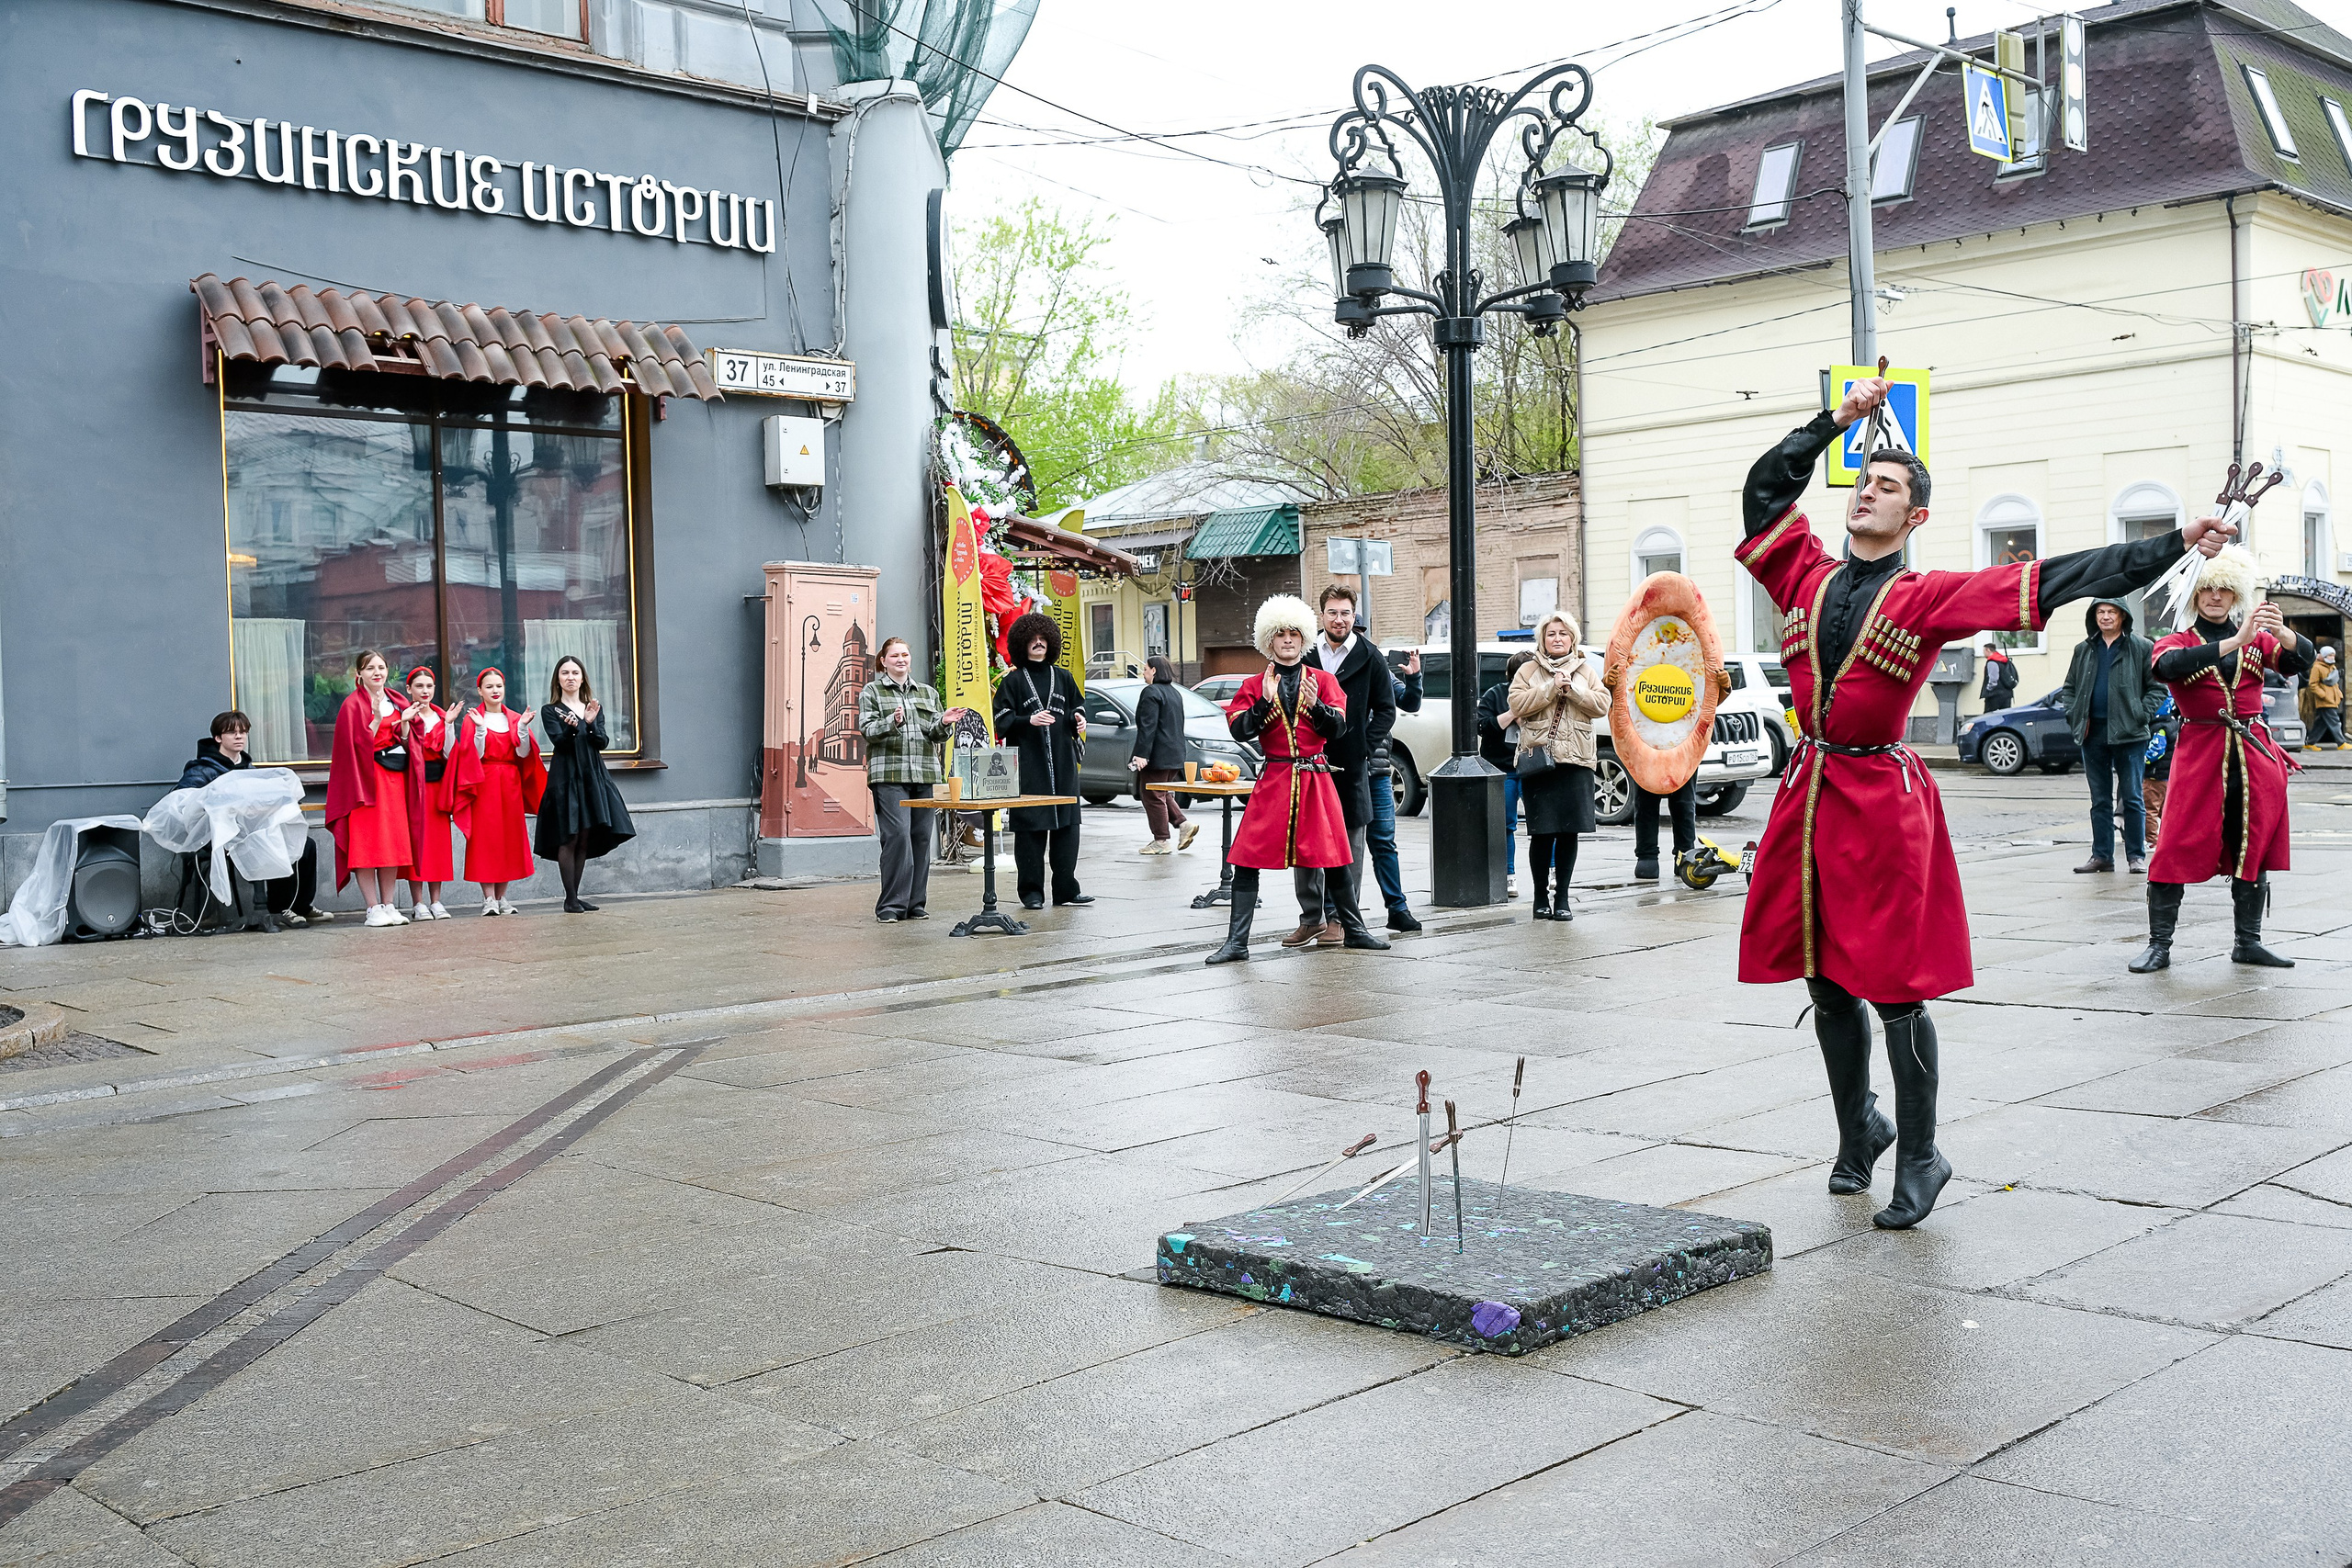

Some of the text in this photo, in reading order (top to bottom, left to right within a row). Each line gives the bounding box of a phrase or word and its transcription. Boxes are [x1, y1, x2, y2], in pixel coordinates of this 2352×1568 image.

[72, 88, 776, 254] ГРУЗИНСКИЕ ИСТОРИИ
[727, 359, 749, 382] 37
[763, 362, 846, 378] ул. Ленинградская
[763, 375, 846, 393] 45 37
[1138, 554, 1156, 568] ЧЕК
[961, 603, 974, 682] ИСТОРИИ
[1061, 611, 1074, 668] СТОРИИ
[1645, 694, 1686, 706] ИСТОРИИ
[1740, 862, 1754, 871] 72
